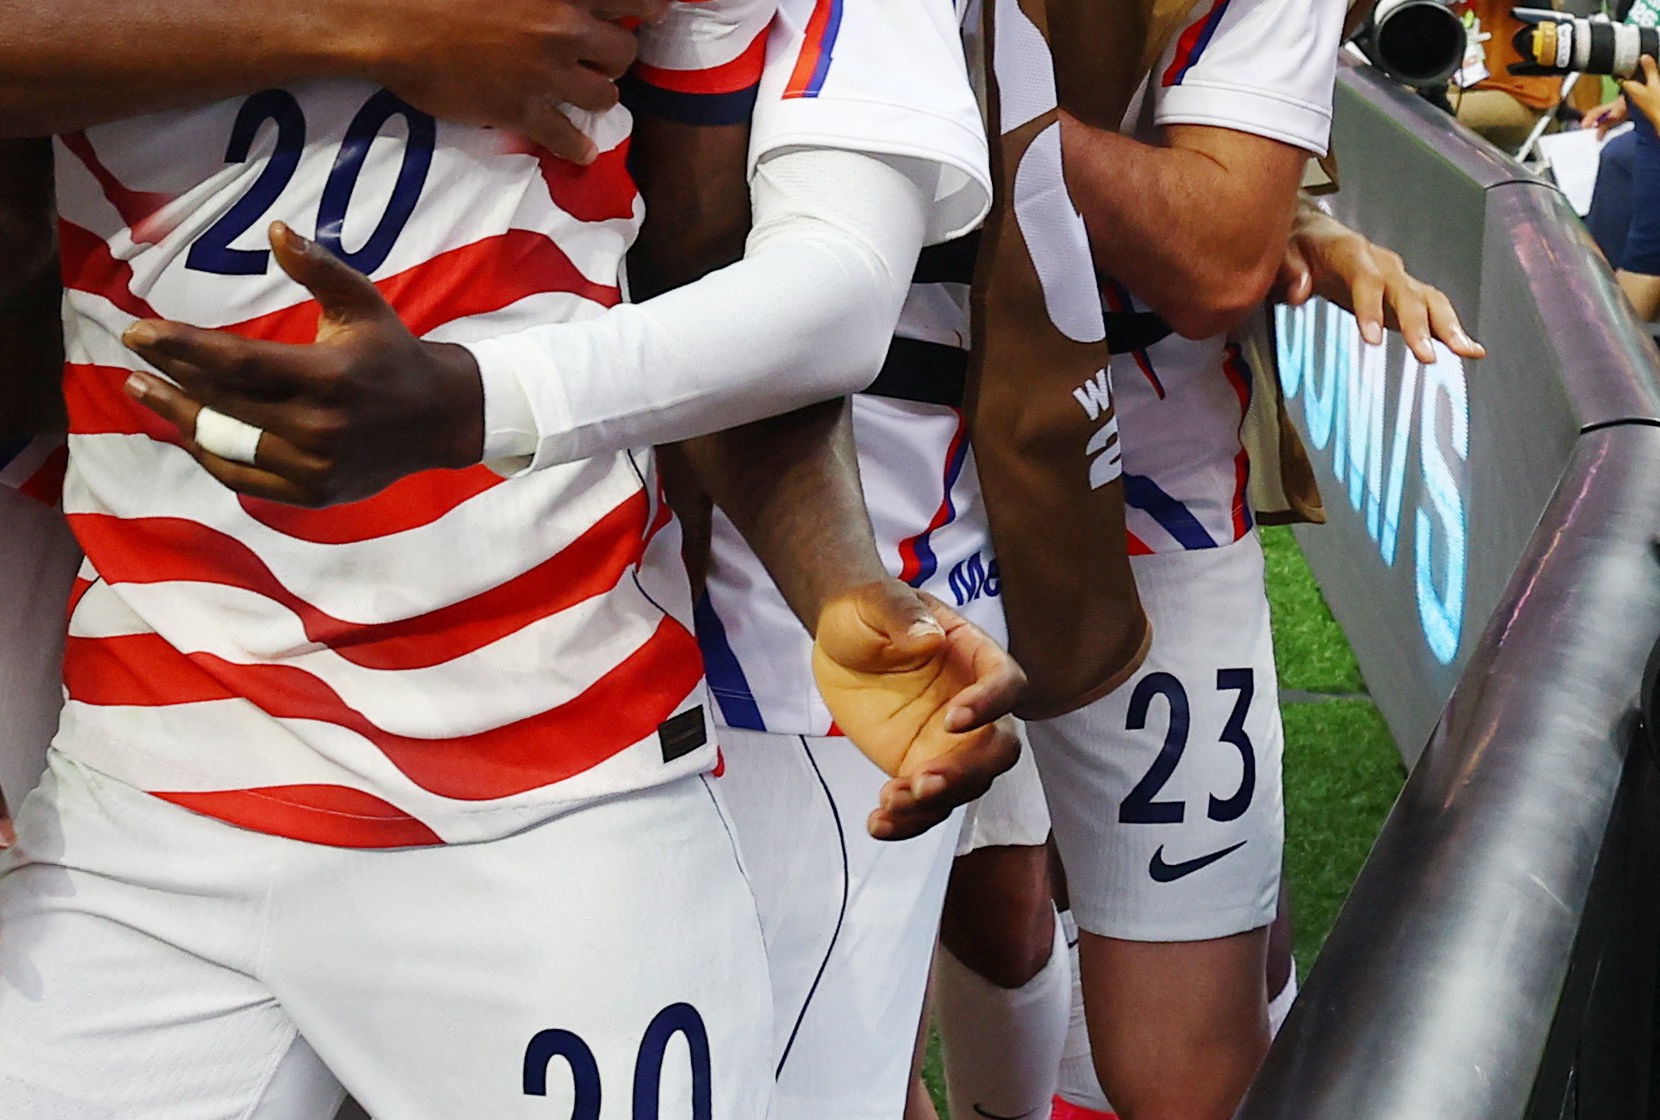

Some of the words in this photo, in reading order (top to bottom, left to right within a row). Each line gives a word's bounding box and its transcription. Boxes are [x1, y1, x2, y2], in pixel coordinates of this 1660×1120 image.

[185, 86, 437, 276] 20
[1072, 364, 1113, 421] W
[1118, 668, 1256, 825] 23
